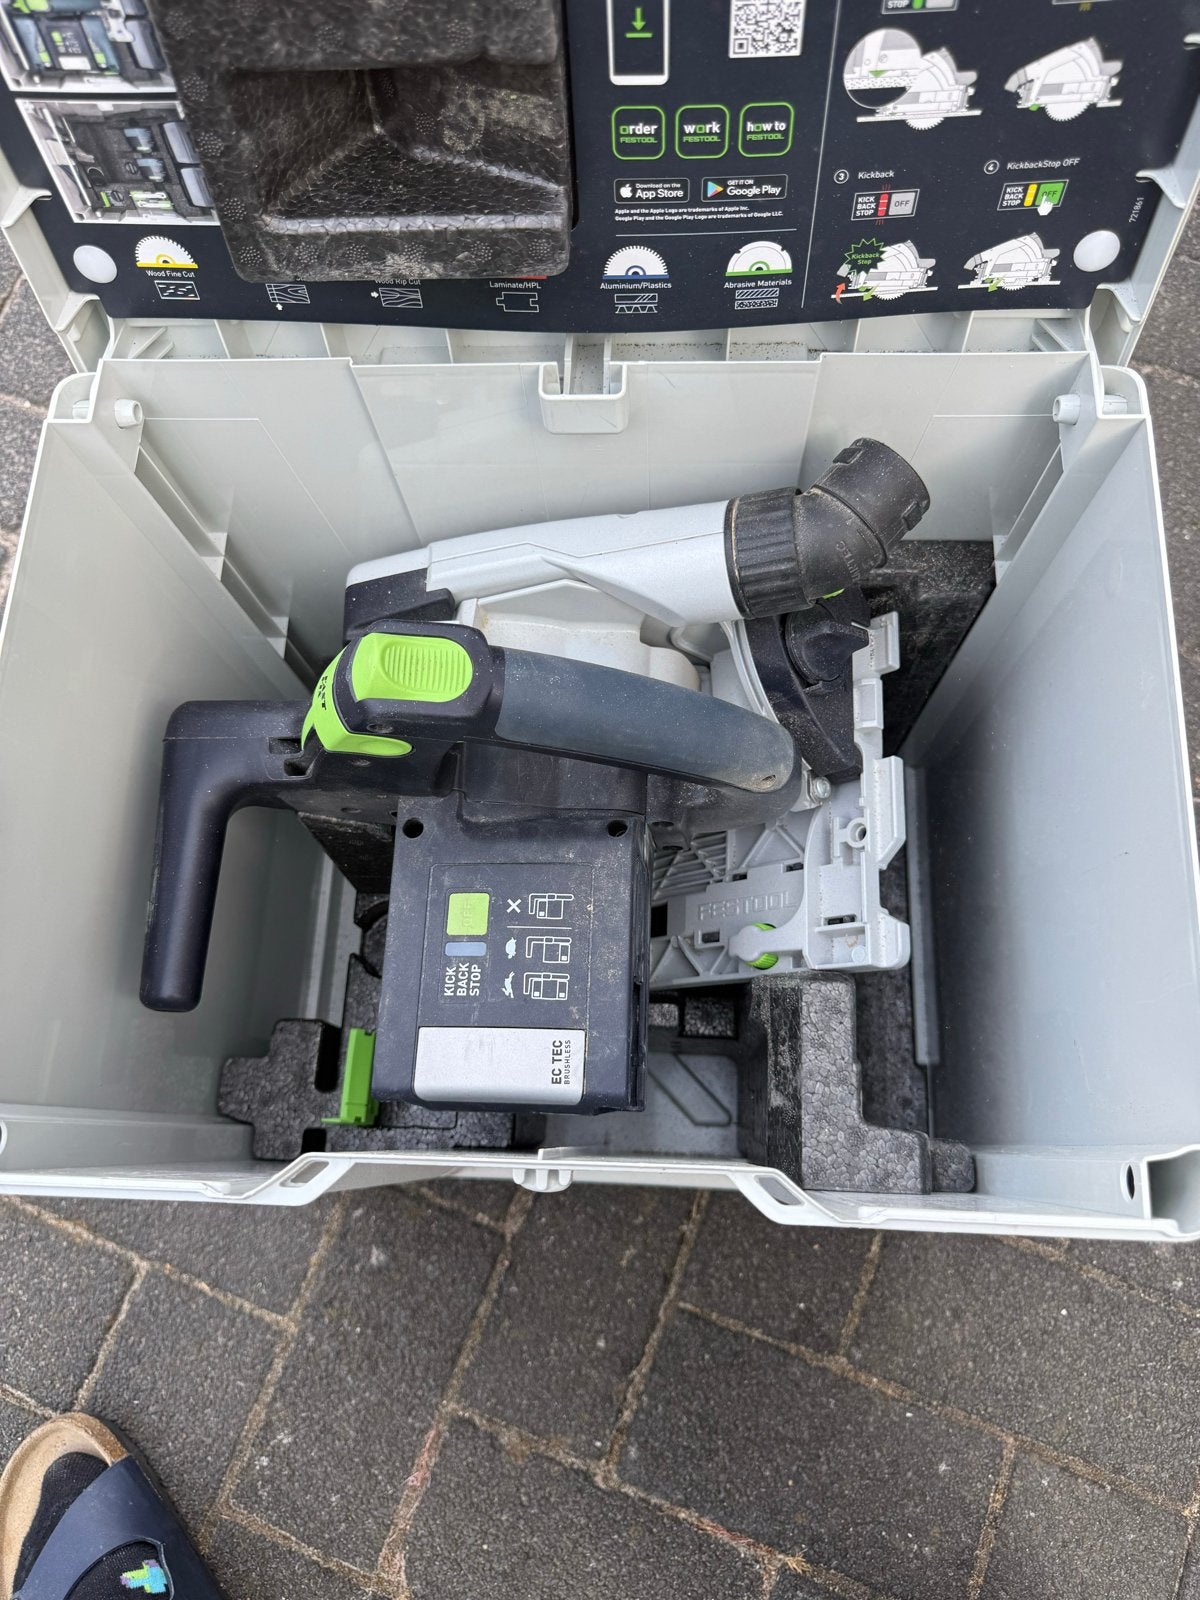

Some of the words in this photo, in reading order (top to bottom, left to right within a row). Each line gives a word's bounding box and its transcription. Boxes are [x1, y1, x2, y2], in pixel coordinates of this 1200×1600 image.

[887, 1, 909, 9] STOP
[620, 123, 658, 135] order
[683, 121, 721, 134] work
[746, 121, 772, 132] how
[774, 121, 786, 131] to
[746, 133, 784, 141] FESTOOL
[1006, 160, 1061, 170] KickbackStop
[1062, 158, 1080, 167] OFF
[858, 170, 895, 179] Kickback
[635, 189, 656, 200] App
[657, 188, 684, 198] Store
[726, 186, 761, 197] Google
[761, 184, 782, 196] Play
[894, 200, 910, 208] OFF
[855, 209, 874, 217] STOP
[851, 252, 880, 260] Kickback
[489, 280, 542, 289] Laminate/HPL
[723, 281, 756, 289] Abrasive
[757, 279, 792, 287] Materials
[443, 966, 457, 996] KICK
[456, 962, 470, 996] BACK
[469, 964, 482, 996] STOP
[551, 1040, 563, 1065] TEC
[563, 1039, 571, 1085] BRUSHLESS
[551, 1068, 562, 1085] EC
